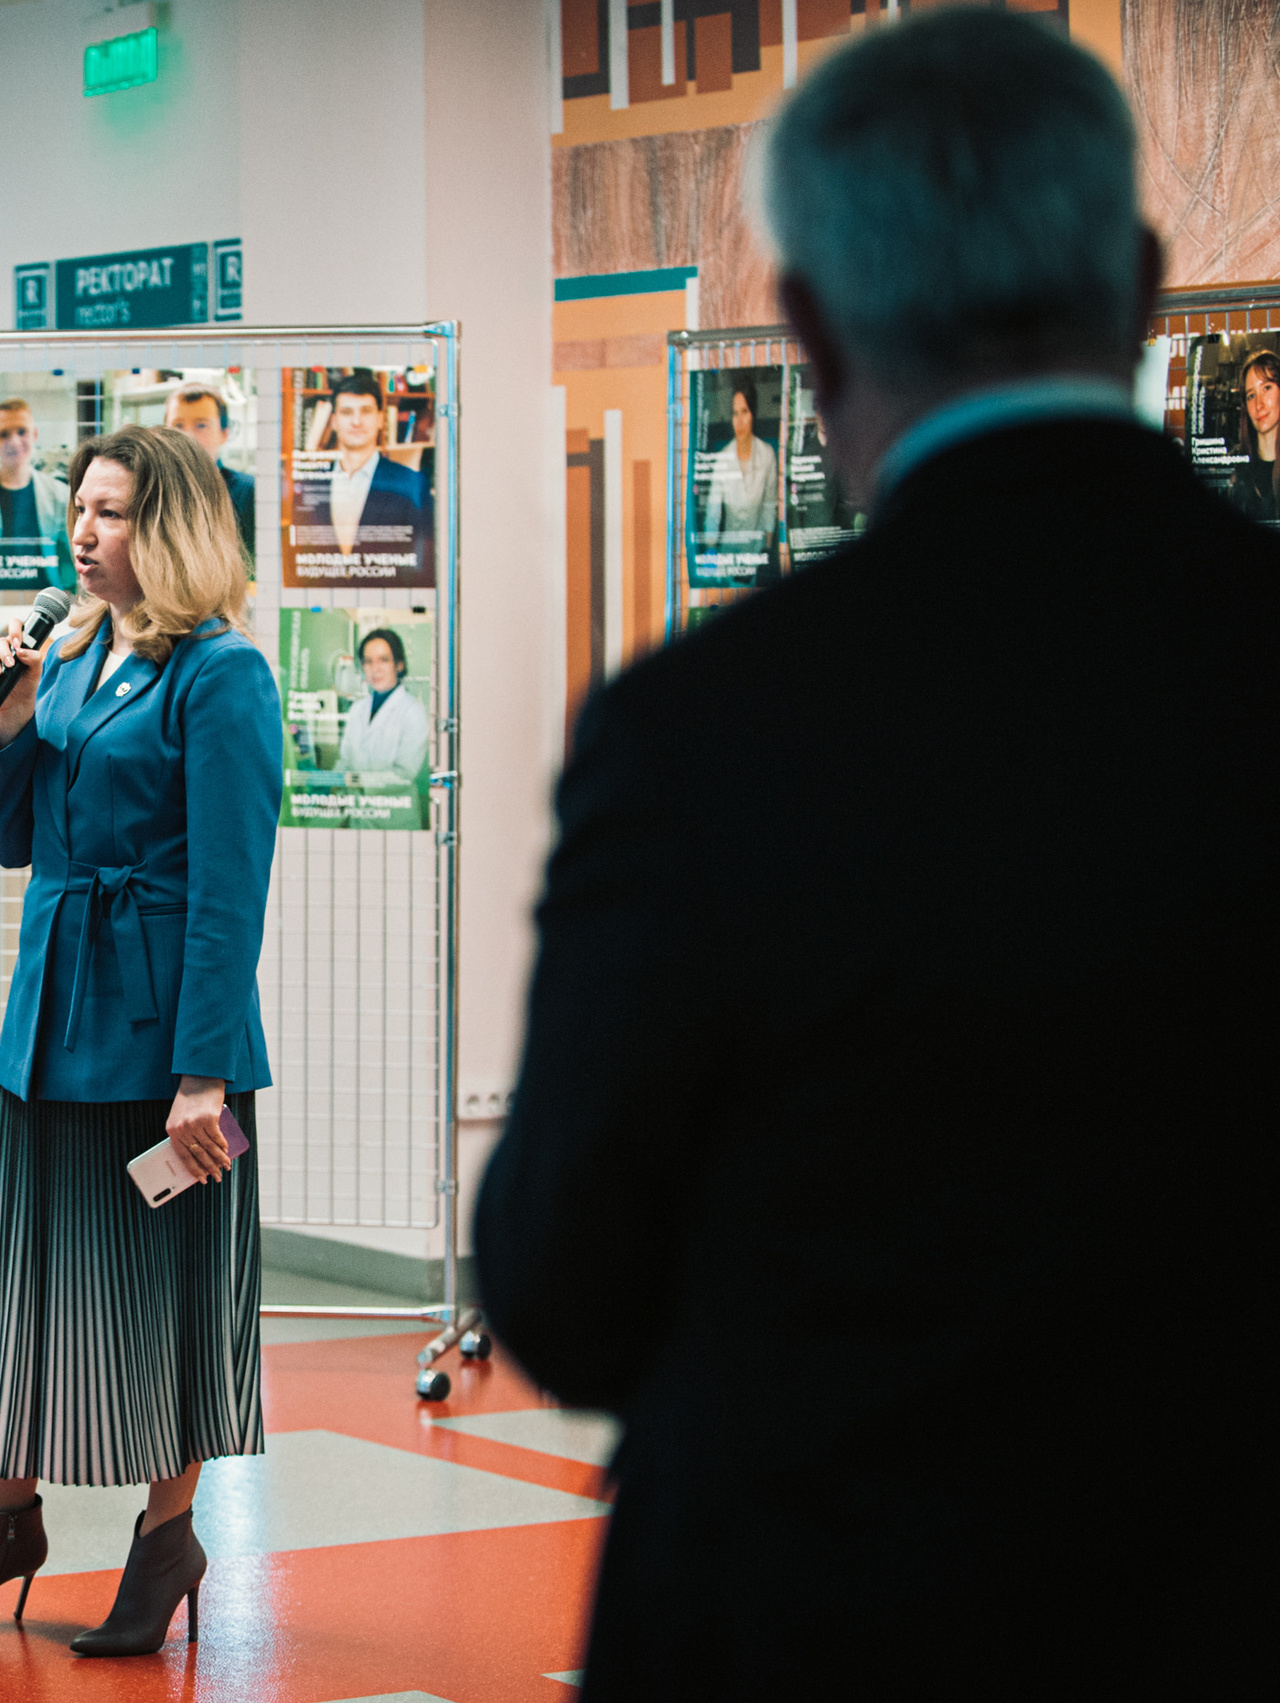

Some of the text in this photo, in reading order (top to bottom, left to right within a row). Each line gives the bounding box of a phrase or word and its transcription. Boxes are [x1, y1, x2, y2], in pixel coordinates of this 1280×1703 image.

[75, 257, 174, 297] РЕКТОРАТ
[1198, 386, 1206, 435] ОБЛАСТЬ
[1191, 437, 1226, 447] Гришина
[1191, 447, 1227, 457] Кристина
[1191, 455, 1251, 466] Александровна
[295, 552, 418, 567] МОЛОДЫЕ УЧЕНЫЕ
[290, 793, 412, 809] МОЛОДЫЕ УЧЕНЫЕ
